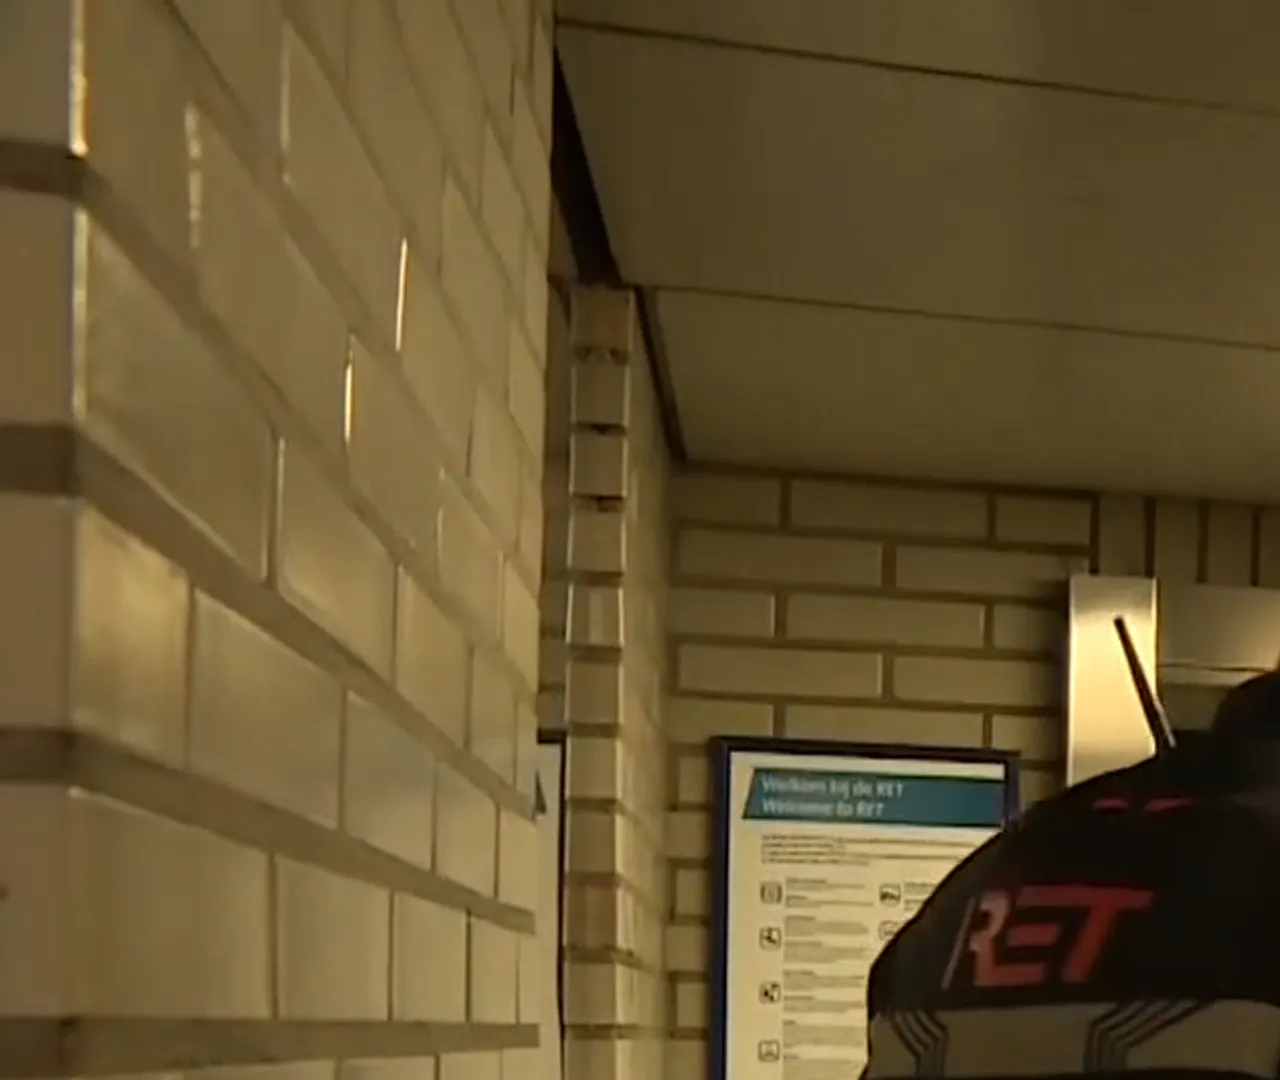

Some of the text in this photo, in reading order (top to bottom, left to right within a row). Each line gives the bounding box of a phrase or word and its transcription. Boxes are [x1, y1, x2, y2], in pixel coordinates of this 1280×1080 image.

[829, 778, 849, 799] bij
[853, 778, 872, 795] de
[876, 781, 904, 798] RET
[836, 800, 853, 816] to
[856, 802, 885, 817] RET
[942, 884, 1154, 990] RET
